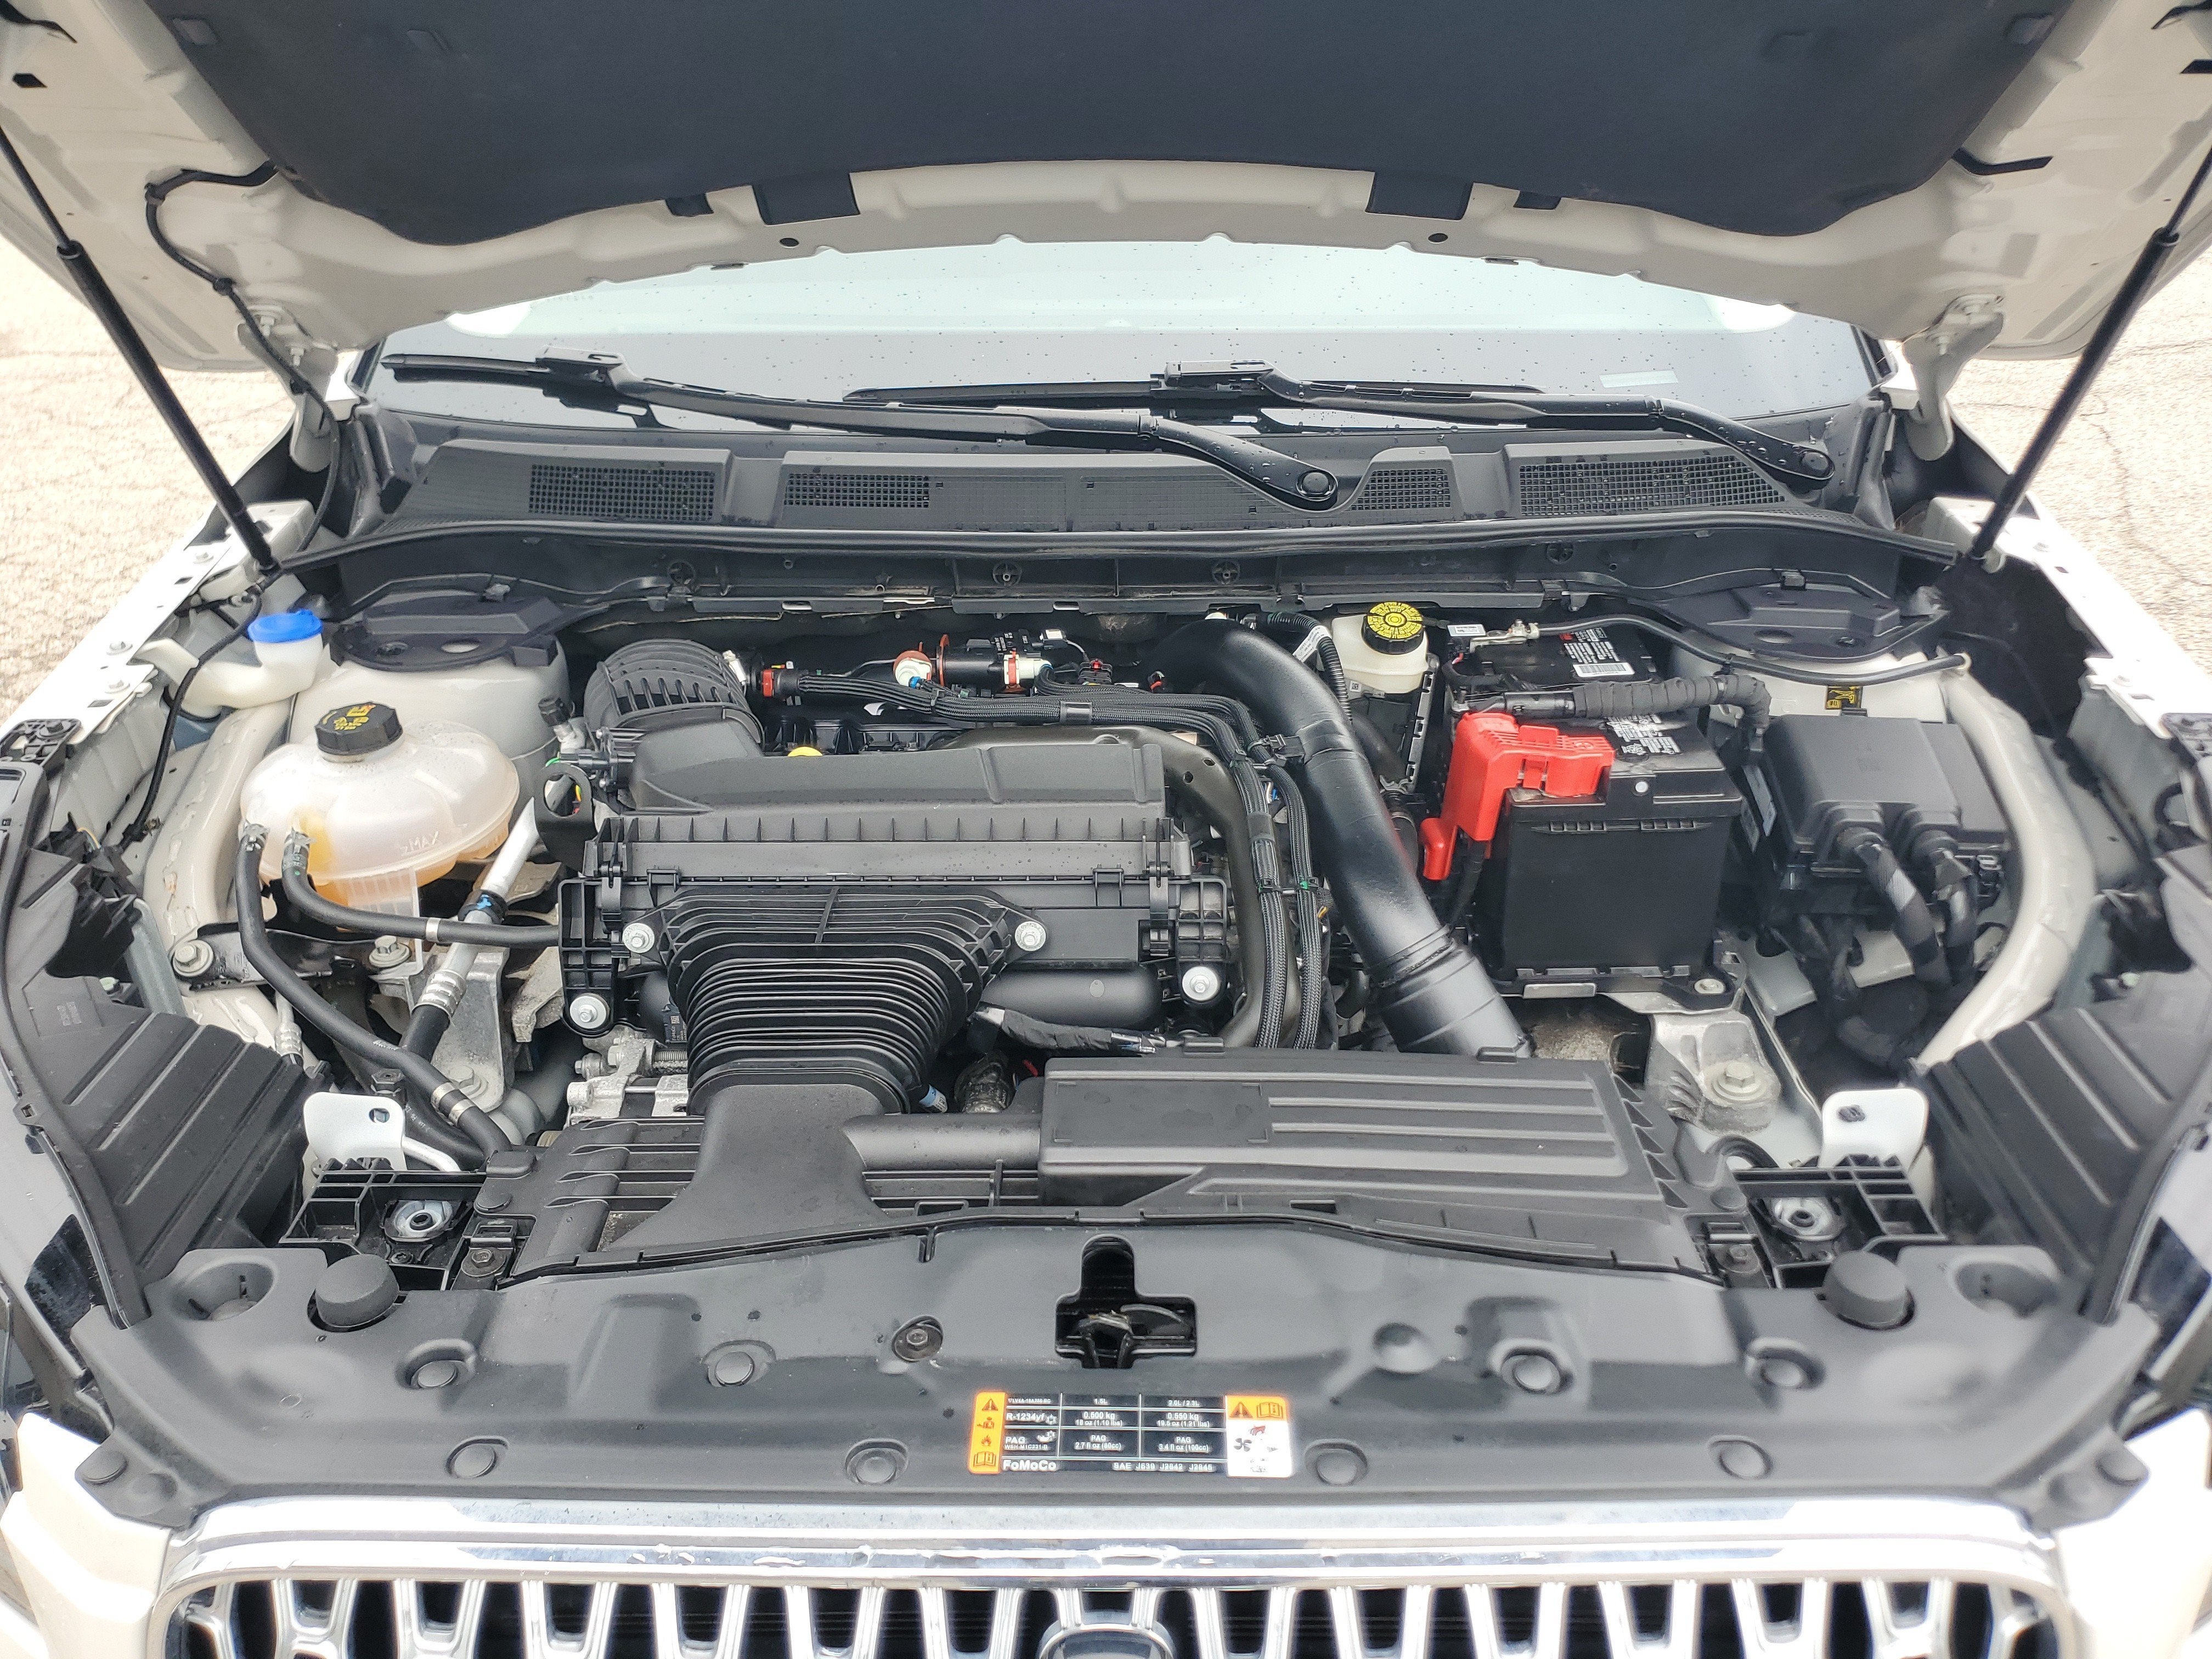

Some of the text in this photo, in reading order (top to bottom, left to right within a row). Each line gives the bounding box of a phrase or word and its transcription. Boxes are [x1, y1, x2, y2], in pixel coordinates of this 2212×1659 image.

[1006, 1413, 1046, 1422] R-1234yf
[1105, 1412, 1115, 1420] kg
[1189, 1413, 1199, 1421] kg
[1003, 1460, 1057, 1470] FoMoCo
